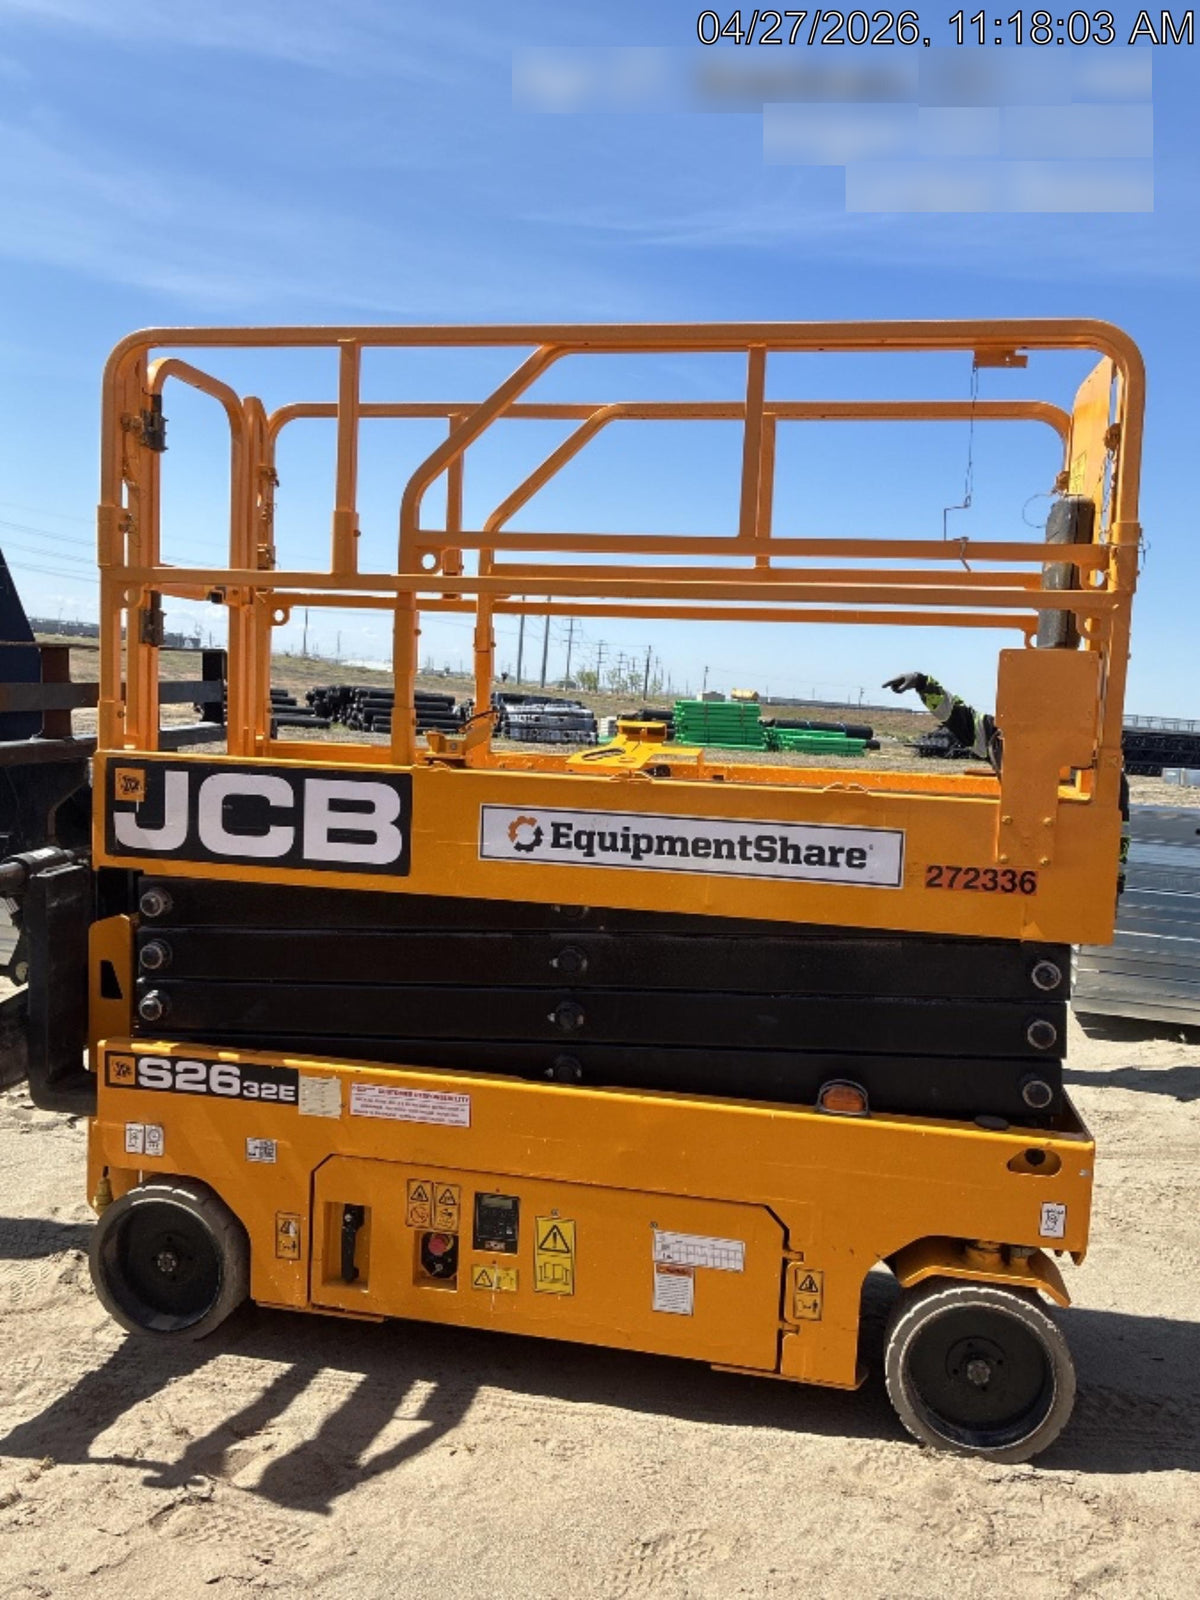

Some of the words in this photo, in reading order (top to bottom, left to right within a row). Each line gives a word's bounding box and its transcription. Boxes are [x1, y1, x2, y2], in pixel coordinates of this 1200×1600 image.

[113, 770, 403, 866] JCB
[550, 821, 868, 870] EquipmentShare
[925, 864, 1037, 895] 272336
